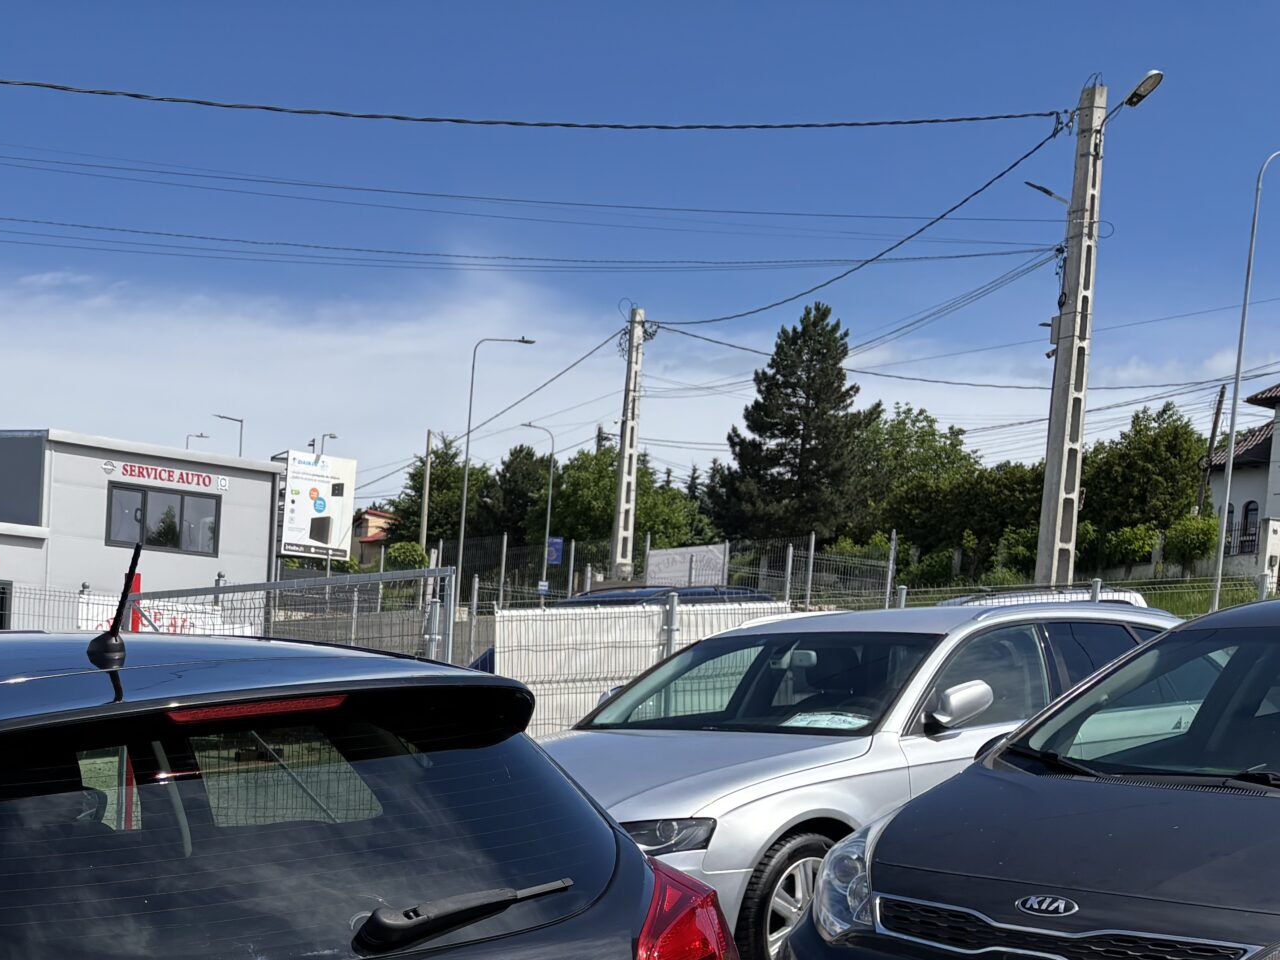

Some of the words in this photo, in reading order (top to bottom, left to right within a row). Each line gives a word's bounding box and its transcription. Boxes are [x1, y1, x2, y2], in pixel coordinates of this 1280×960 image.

[121, 463, 175, 483] SERVICE
[176, 471, 212, 488] AUTO
[1024, 895, 1066, 913] KIA
